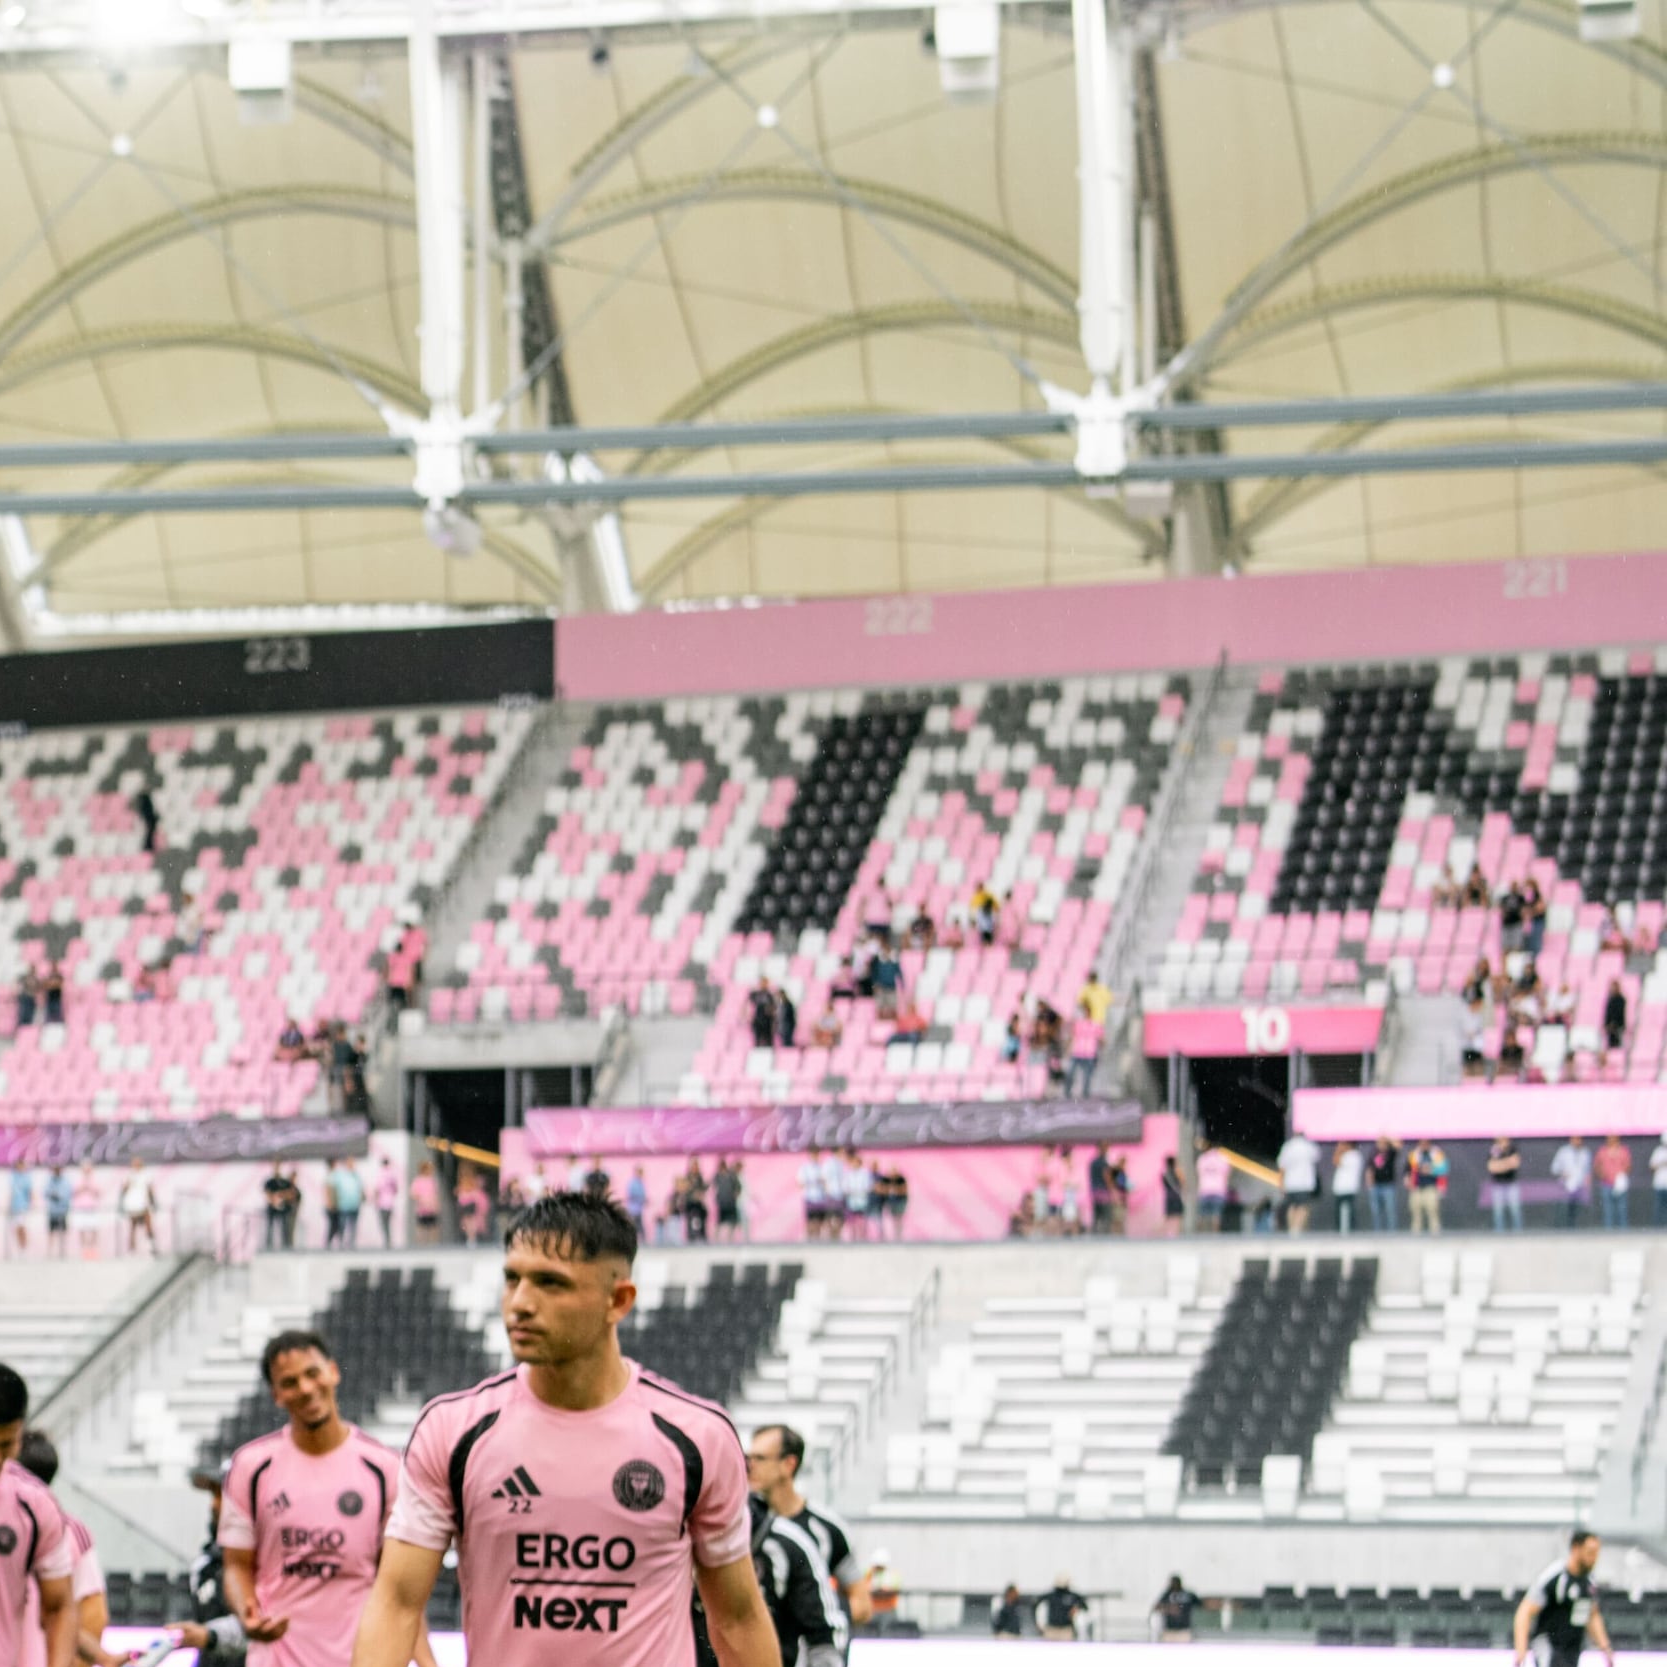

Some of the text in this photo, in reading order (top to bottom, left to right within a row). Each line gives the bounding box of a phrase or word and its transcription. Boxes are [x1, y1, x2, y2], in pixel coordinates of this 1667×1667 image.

[1502, 557, 1569, 600] 221
[863, 595, 935, 637] 222
[243, 637, 312, 675] 223
[1240, 1005, 1291, 1054] 10
[507, 1499, 533, 1515] 22
[514, 1531, 637, 1572] ERGO
